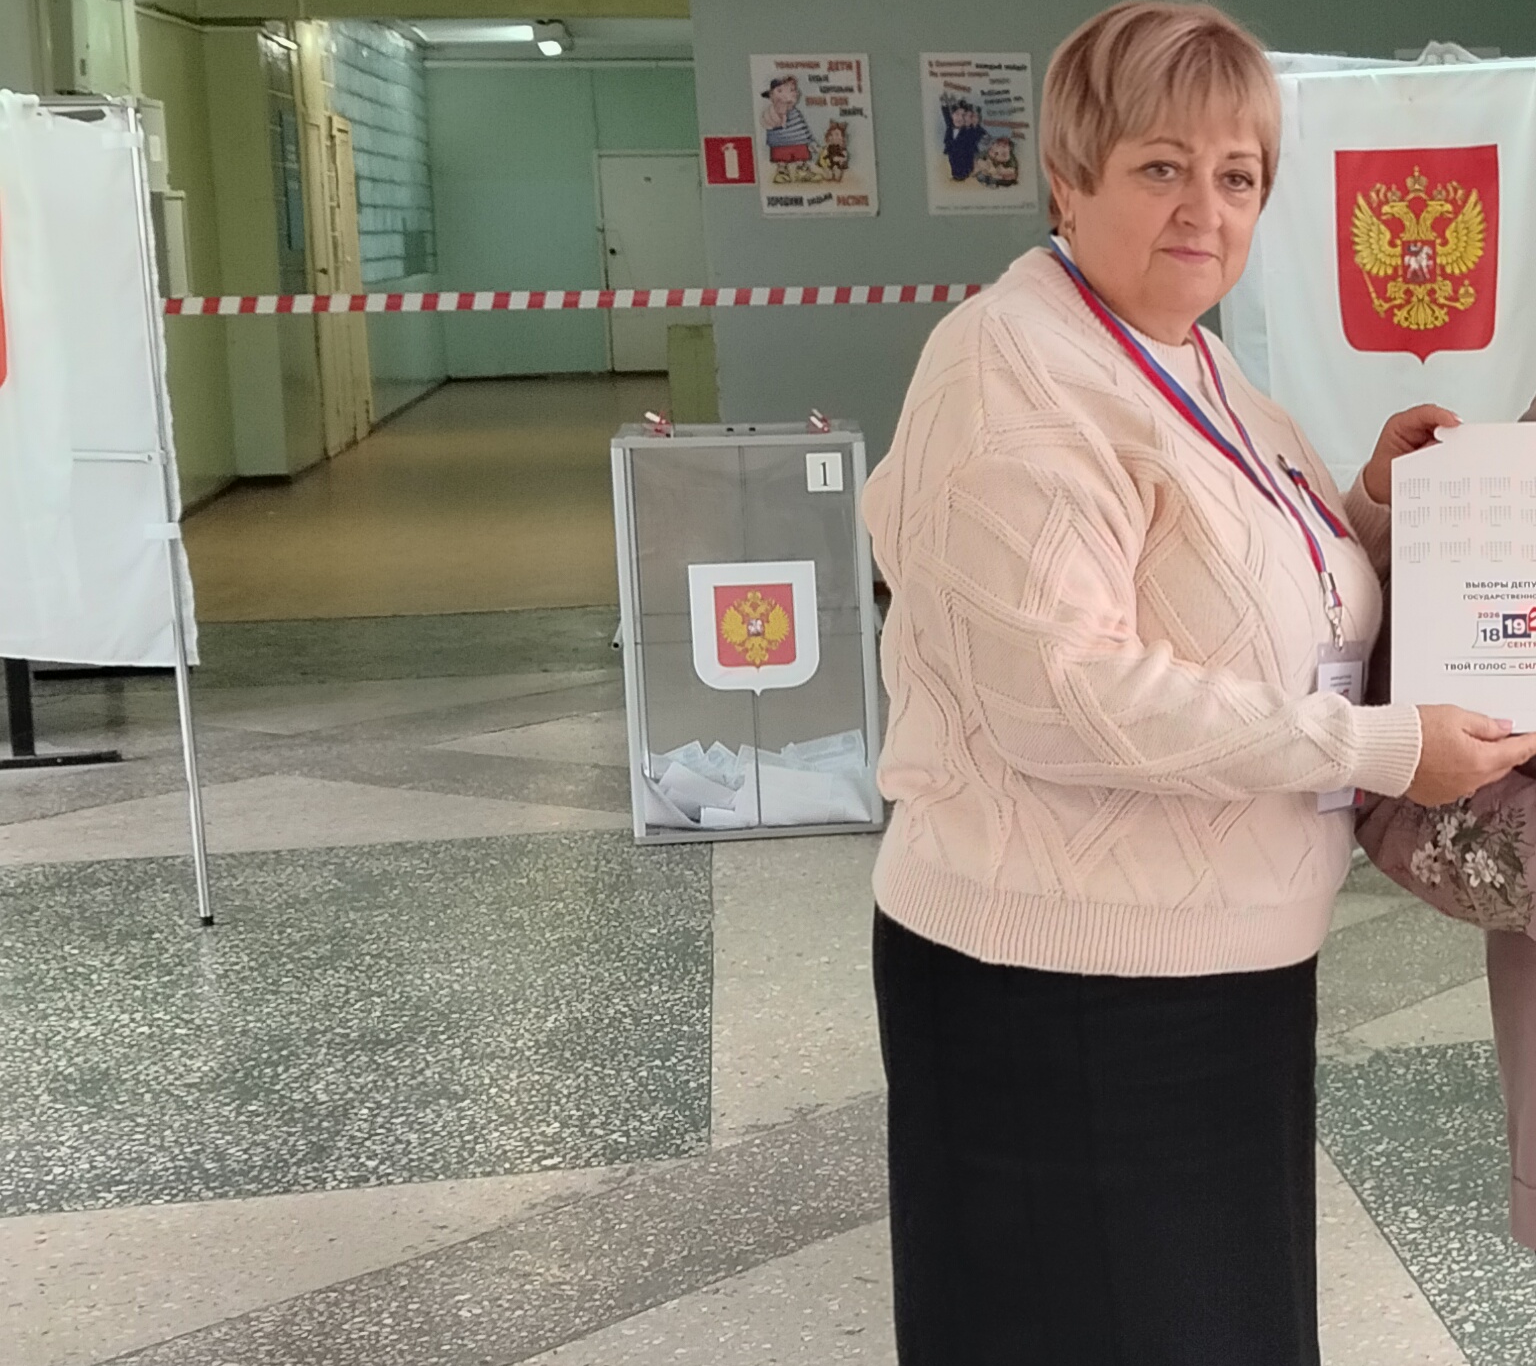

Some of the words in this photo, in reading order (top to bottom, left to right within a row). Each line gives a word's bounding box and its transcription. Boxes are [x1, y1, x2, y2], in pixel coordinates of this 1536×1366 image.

[820, 461, 829, 487] 1
[1465, 581, 1509, 589] ВЫБОРЫ
[1480, 628, 1501, 642] 18
[1504, 619, 1526, 635] 19
[1444, 662, 1471, 671] ТВОЙ
[1473, 663, 1507, 671] ГОЛОС
